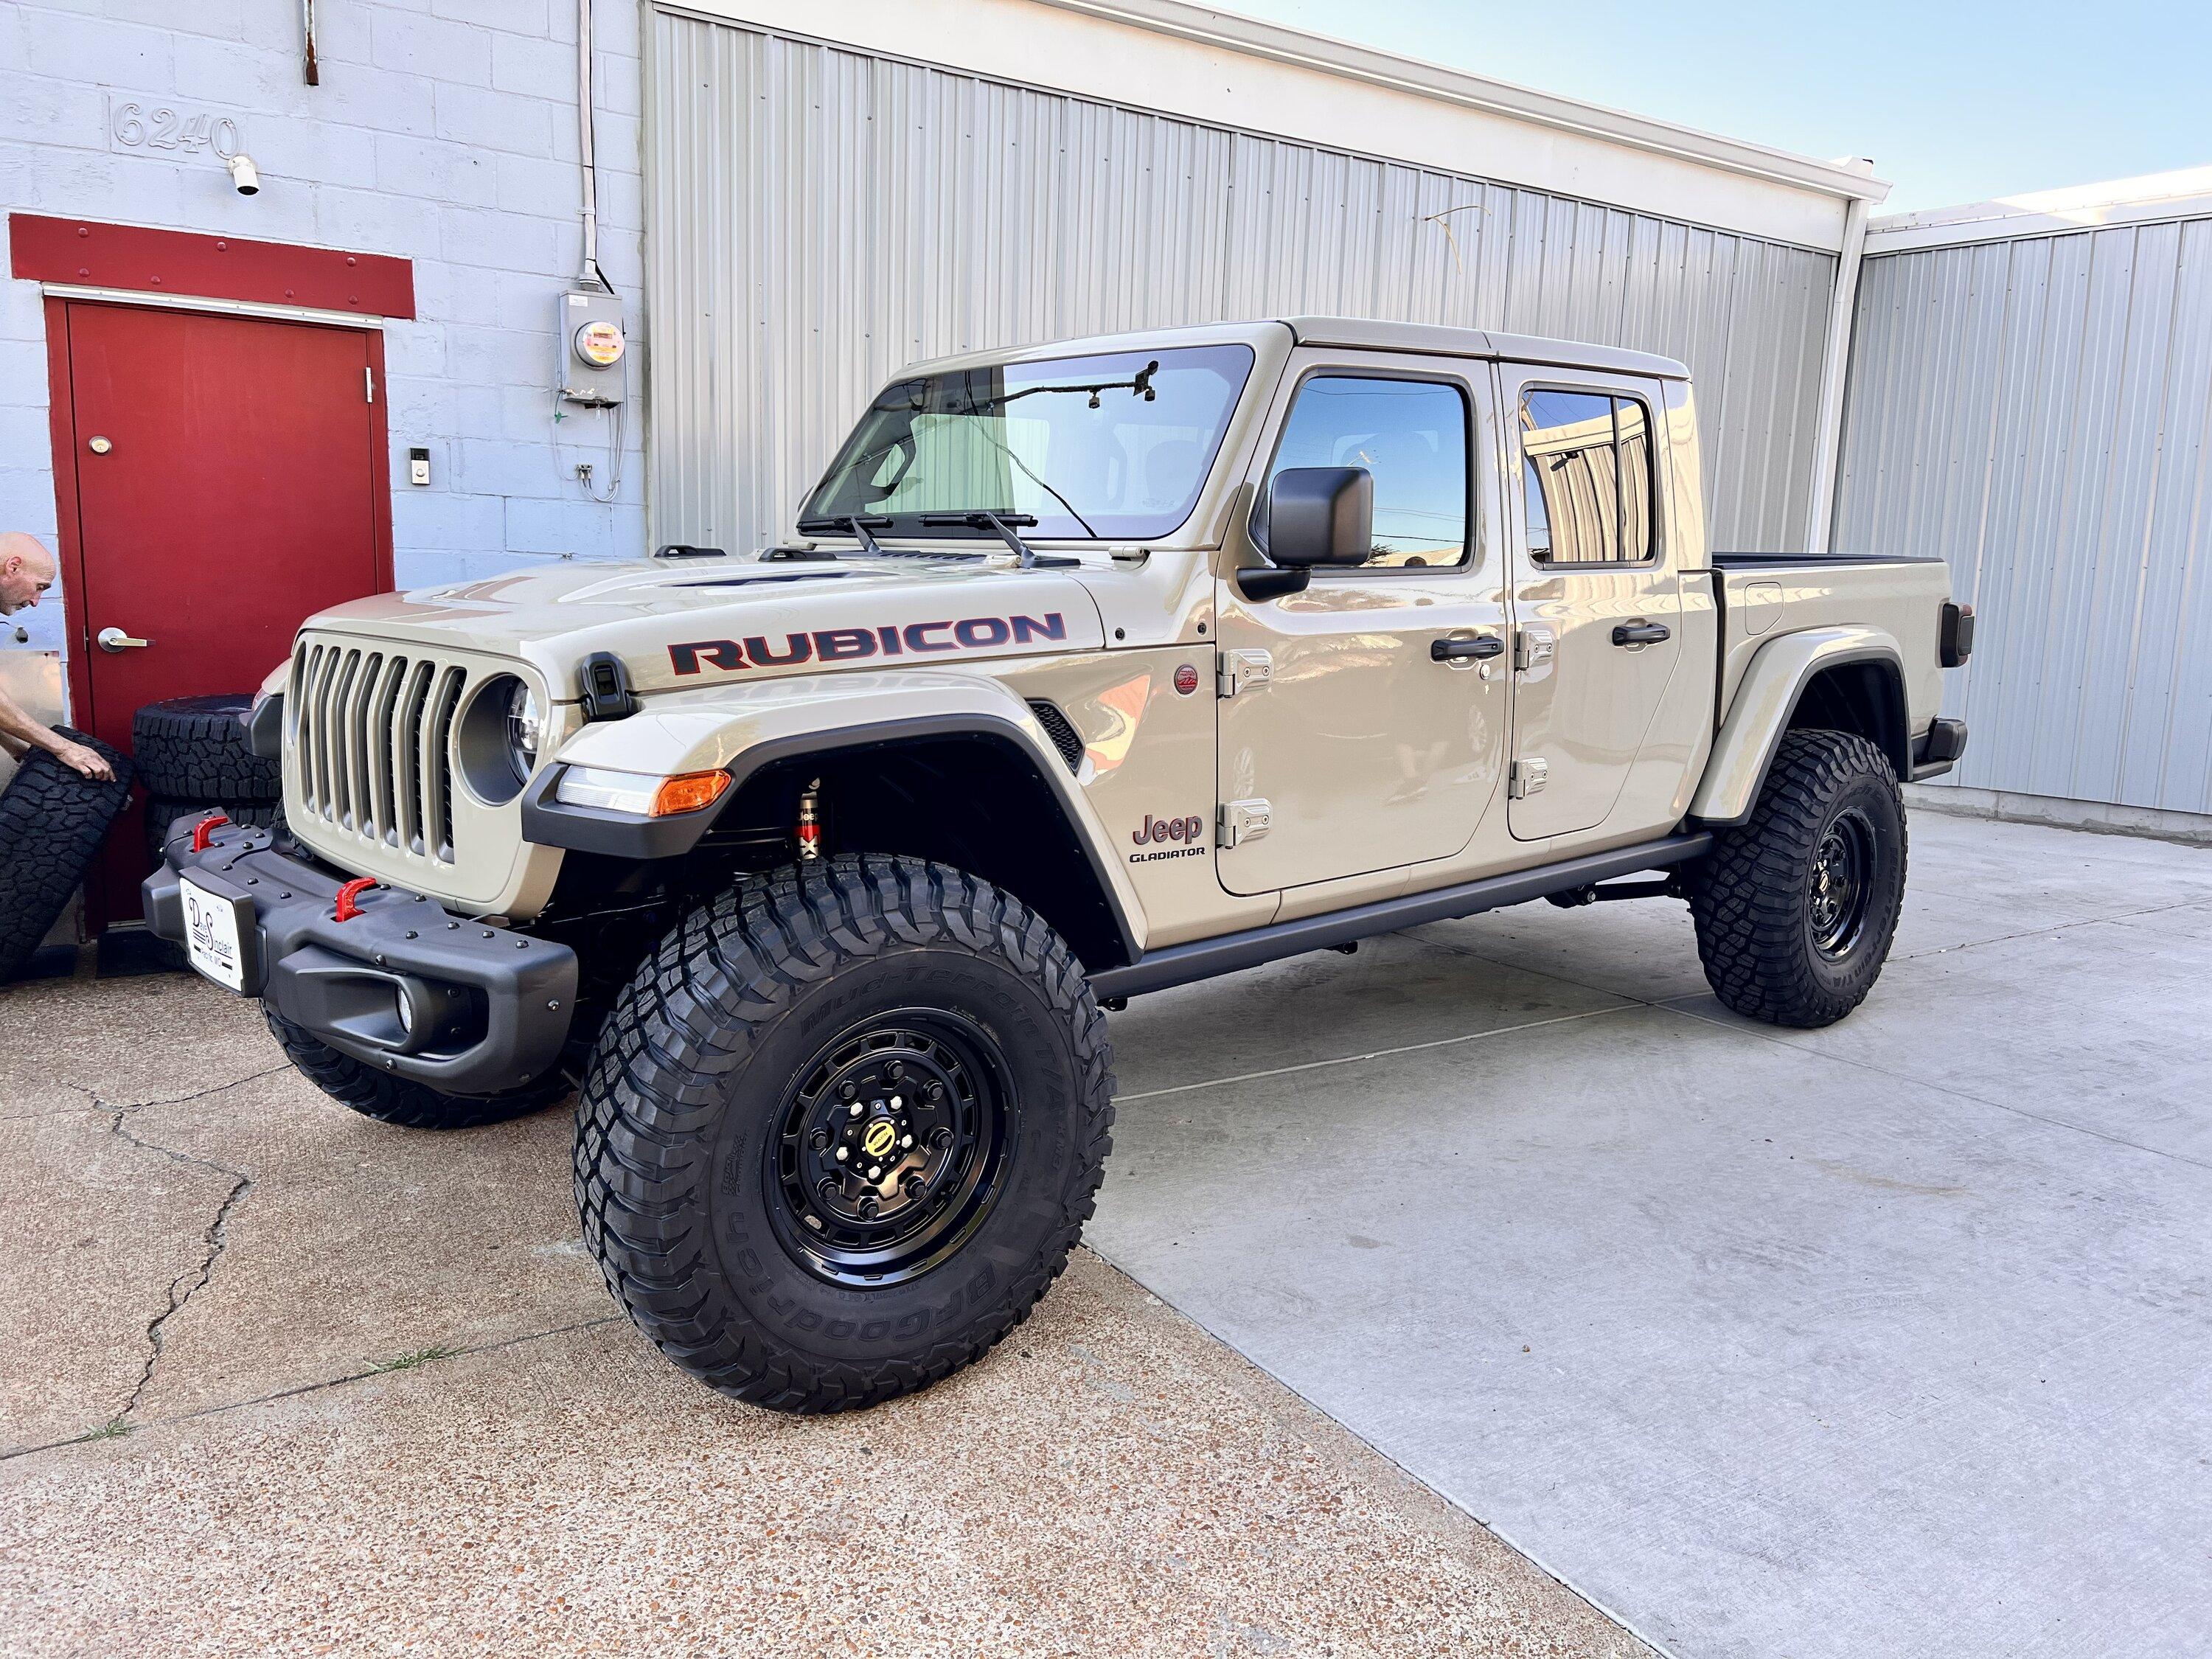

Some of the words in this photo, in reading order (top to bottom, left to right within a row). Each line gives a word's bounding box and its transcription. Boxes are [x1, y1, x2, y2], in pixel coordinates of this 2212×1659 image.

[115, 103, 240, 160] 6240
[667, 613, 1067, 676] RUBICON
[1129, 847, 1206, 863] GLADIATOR
[1133, 815, 1203, 845] Jeep
[189, 897, 207, 934] Dave
[205, 912, 233, 956] Sinclair
[801, 962, 1041, 1039] Mud-Terrain
[726, 1211, 998, 1342] BFGoodrich
